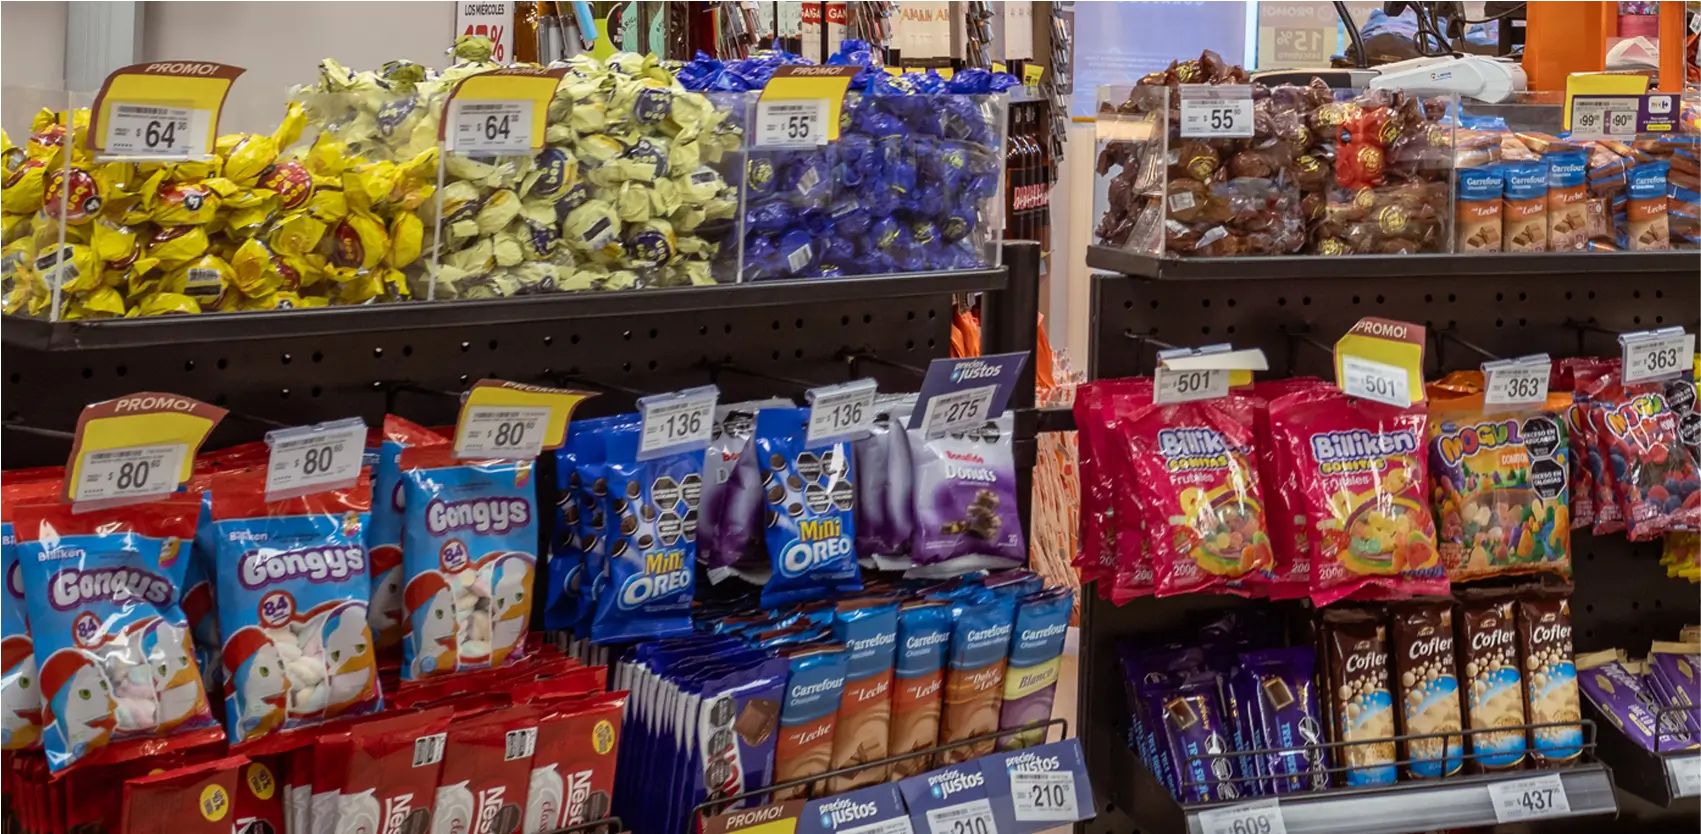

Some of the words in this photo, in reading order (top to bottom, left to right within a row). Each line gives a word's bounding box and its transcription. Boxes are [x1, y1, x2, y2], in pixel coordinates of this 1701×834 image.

[464, 4, 479, 16] LOS
[145, 63, 220, 76] PROMO!
[790, 67, 845, 76] PROMO!
[485, 115, 510, 140] 64
[788, 116, 809, 139] 55
[1211, 109, 1234, 130] 55
[145, 121, 176, 149] 64
[1551, 163, 1585, 173] Carrefour
[1467, 176, 1502, 186] Carrefour
[1511, 176, 1546, 186] Carrefour
[1563, 192, 1584, 204] Leche
[1646, 203, 1667, 215] Leche
[1477, 205, 1499, 217] Leche
[1522, 204, 1544, 215] Leche
[1357, 319, 1408, 339] PROMO!
[955, 359, 986, 370] precios
[1647, 348, 1678, 372] 363
[956, 364, 1003, 384] justos
[1177, 370, 1211, 393] 501
[1365, 375, 1396, 397] 501
[1508, 378, 1539, 398] 363
[114, 396, 197, 413] PROMO!
[832, 401, 863, 429] 136
[947, 399, 980, 423] 275
[494, 422, 525, 447] 80
[667, 410, 702, 438] 136
[1313, 432, 1414, 460] Billiken
[1439, 420, 1524, 464] MOGUL
[303, 446, 333, 475] 80
[117, 460, 150, 490] 80
[945, 463, 997, 482] Donuts
[428, 500, 528, 534] Gongys
[800, 520, 841, 542] Mini
[443, 547, 464, 563] 84
[645, 552, 684, 576] Mini
[784, 538, 852, 573] OREO
[242, 547, 366, 586] Gongys
[1173, 564, 1198, 578] 200g
[52, 570, 169, 608] Gongys
[622, 570, 691, 605] OREO
[263, 596, 289, 617] 84
[906, 630, 950, 650] Carrefour
[967, 622, 1012, 642] Carrefour
[1021, 622, 1067, 642] Carrefour
[1472, 630, 1515, 650] Cofler
[1532, 623, 1572, 645] Cofler
[1408, 636, 1453, 660] Cofler
[1346, 651, 1388, 673] Cofler
[791, 676, 845, 699] Carrefour
[915, 679, 943, 700] Leche
[1018, 667, 1055, 690] Blanco
[858, 680, 889, 702] Leche
[798, 723, 832, 745] Leche
[1005, 752, 1036, 767] precios
[1015, 755, 1061, 772] justos
[928, 769, 960, 787] precios
[940, 772, 985, 800] justos
[1032, 784, 1065, 807] 210
[1521, 789, 1554, 811] 437
[725, 804, 785, 830] PROMO!
[819, 798, 852, 816] precios
[832, 800, 878, 830] justos
